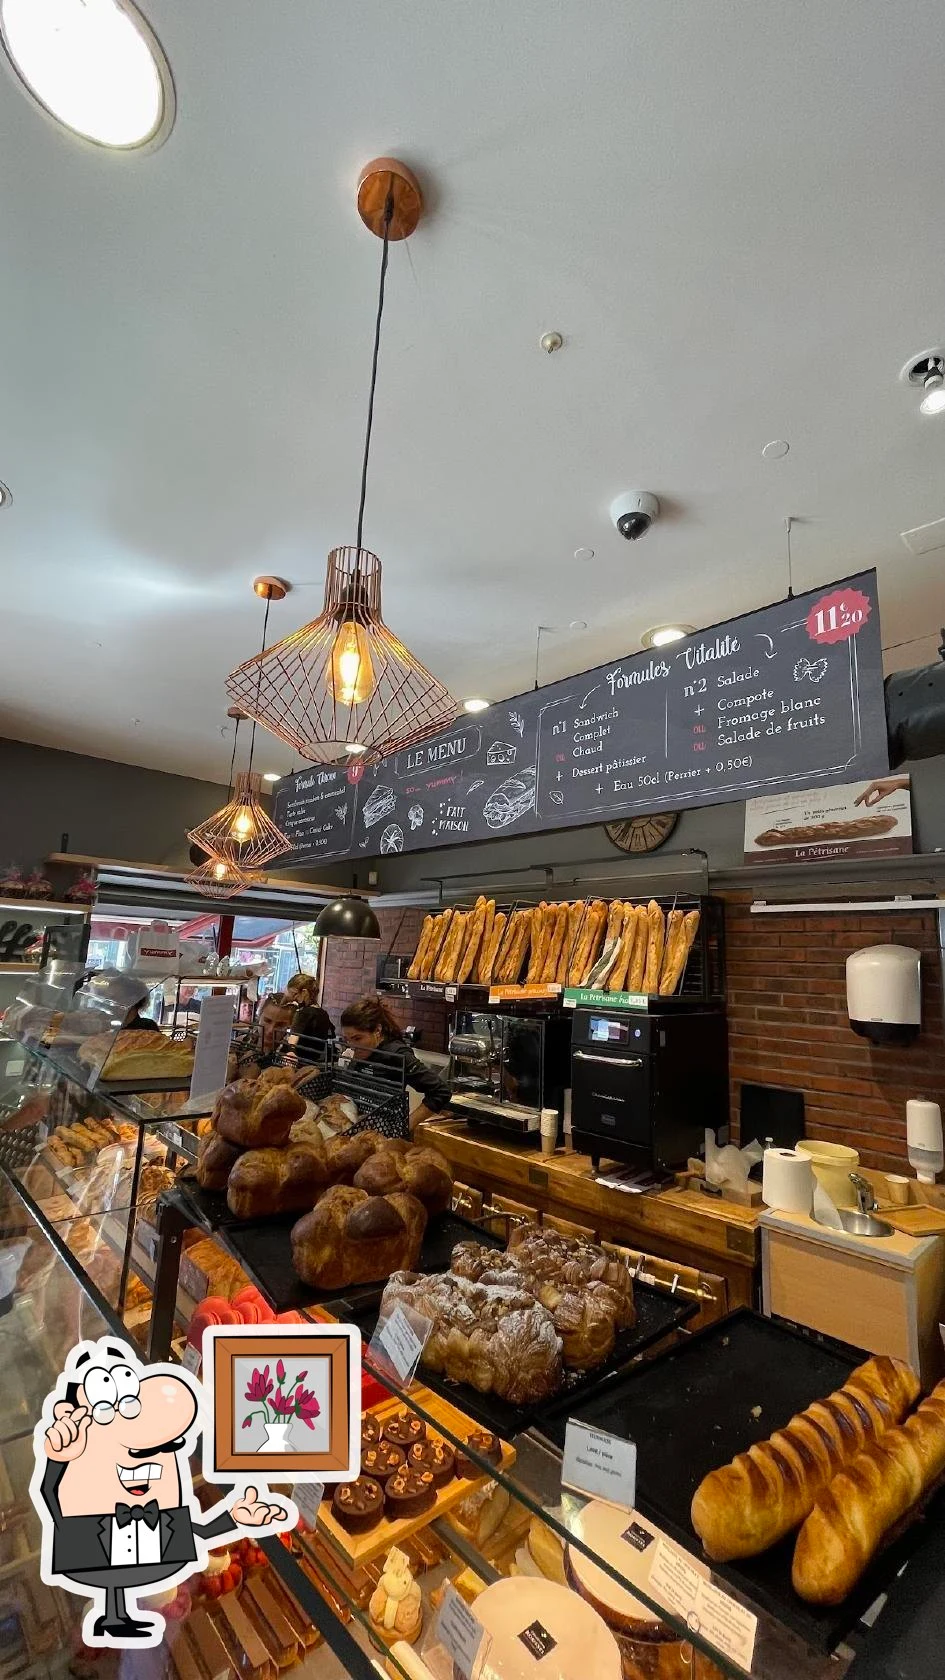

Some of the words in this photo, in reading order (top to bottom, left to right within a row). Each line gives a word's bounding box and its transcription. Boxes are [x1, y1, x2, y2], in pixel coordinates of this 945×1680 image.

[606, 661, 671, 696] Formules
[676, 635, 741, 670] Vitalité
[716, 667, 760, 688] Salade
[717, 688, 775, 711] Compote
[573, 707, 619, 729] Sandwich
[717, 708, 776, 729] Fromage
[780, 697, 821, 714] blanc
[573, 725, 611, 743] Complet
[717, 725, 762, 746] Salade
[766, 722, 783, 736] de
[787, 713, 826, 732] fruits
[406, 751, 424, 769] LE
[427, 737, 467, 763] MENU
[572, 741, 603, 757] Chaud
[572, 765, 603, 778] Dessert
[605, 755, 647, 774] pâtissier
[613, 780, 634, 792] Eau
[638, 772, 660, 786] 50cl
[664, 769, 701, 783] (Perrier
[715, 755, 753, 773] 0,50€)
[446, 806, 466, 818] FAIT
[438, 819, 469, 832] MAISON
[794, 849, 806, 858] La
[808, 846, 849, 856] Pétrisane
[589, 993, 619, 1003] Pétrisane
